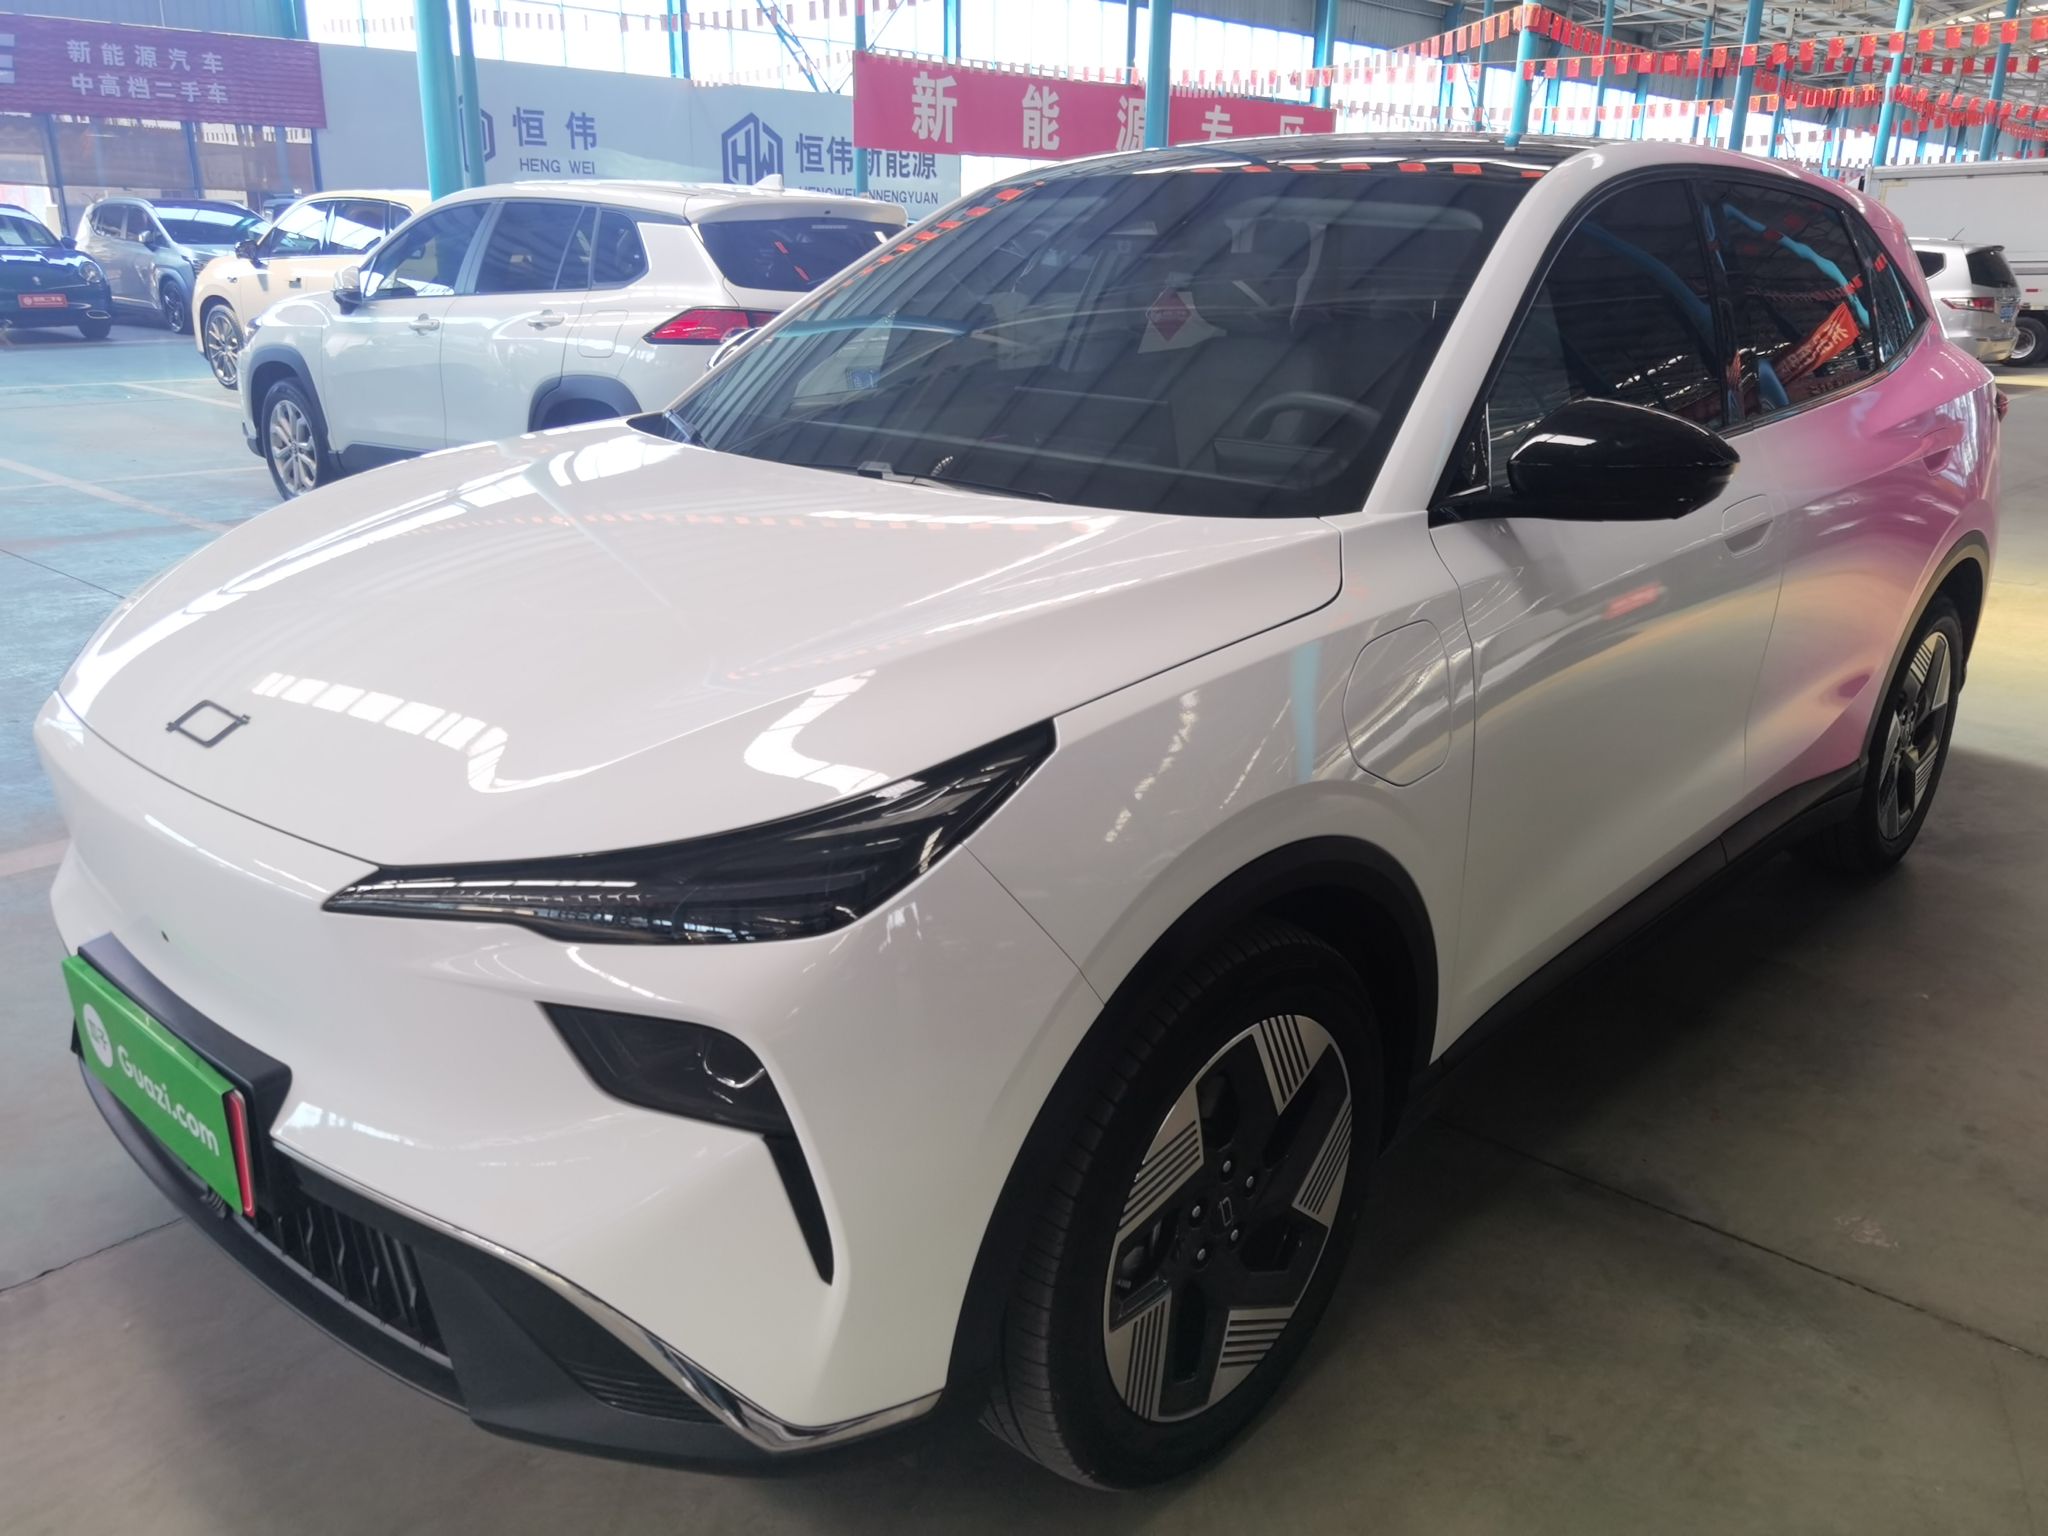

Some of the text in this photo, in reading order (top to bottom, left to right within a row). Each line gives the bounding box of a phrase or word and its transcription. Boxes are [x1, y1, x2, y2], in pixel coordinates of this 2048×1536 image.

[66, 39, 224, 75] 新能源汽车
[71, 72, 229, 104] 中高档二手车
[512, 105, 598, 151] 恒伟
[519, 157, 596, 175] HENG WEI
[117, 1044, 221, 1158] Guazi.com
